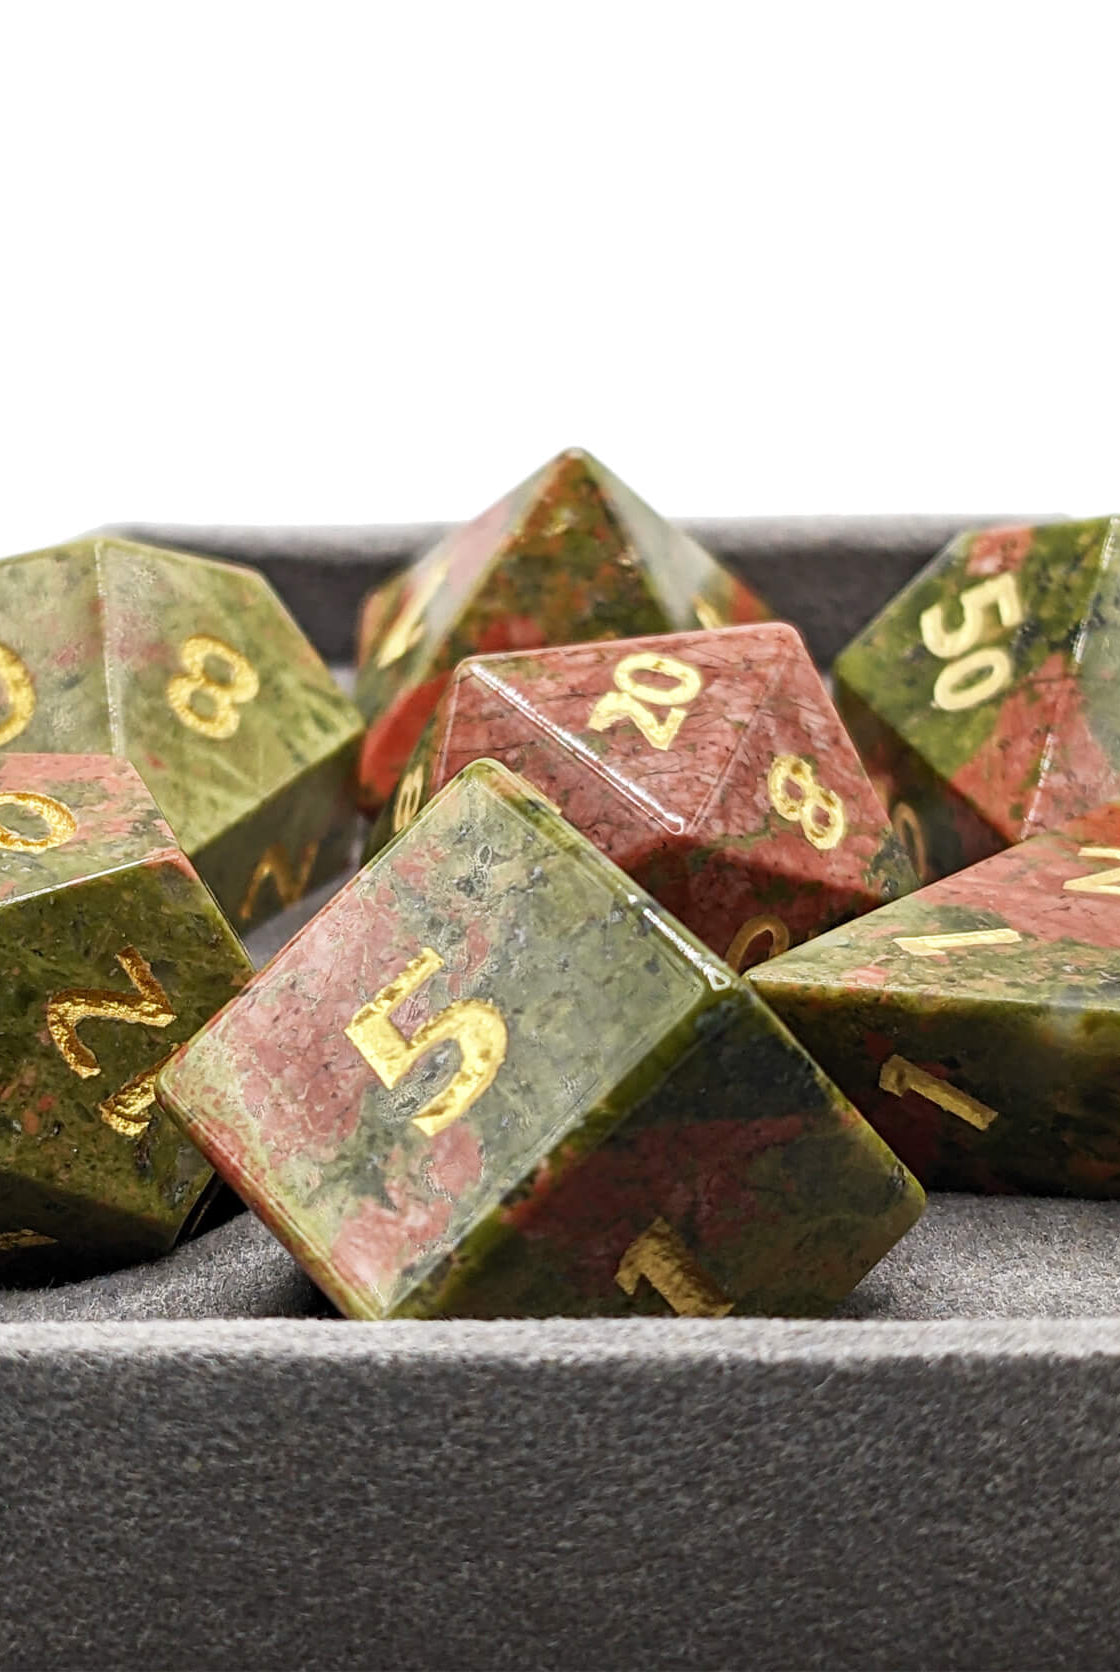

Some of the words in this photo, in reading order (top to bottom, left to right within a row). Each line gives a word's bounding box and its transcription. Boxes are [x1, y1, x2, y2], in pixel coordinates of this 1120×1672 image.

[167, 633, 259, 740] 8
[920, 573, 1023, 711] 50
[588, 652, 701, 751] 20
[768, 755, 845, 850] 8
[892, 928, 1022, 957] 1
[343, 946, 508, 1137] 5
[879, 1054, 999, 1131] 1
